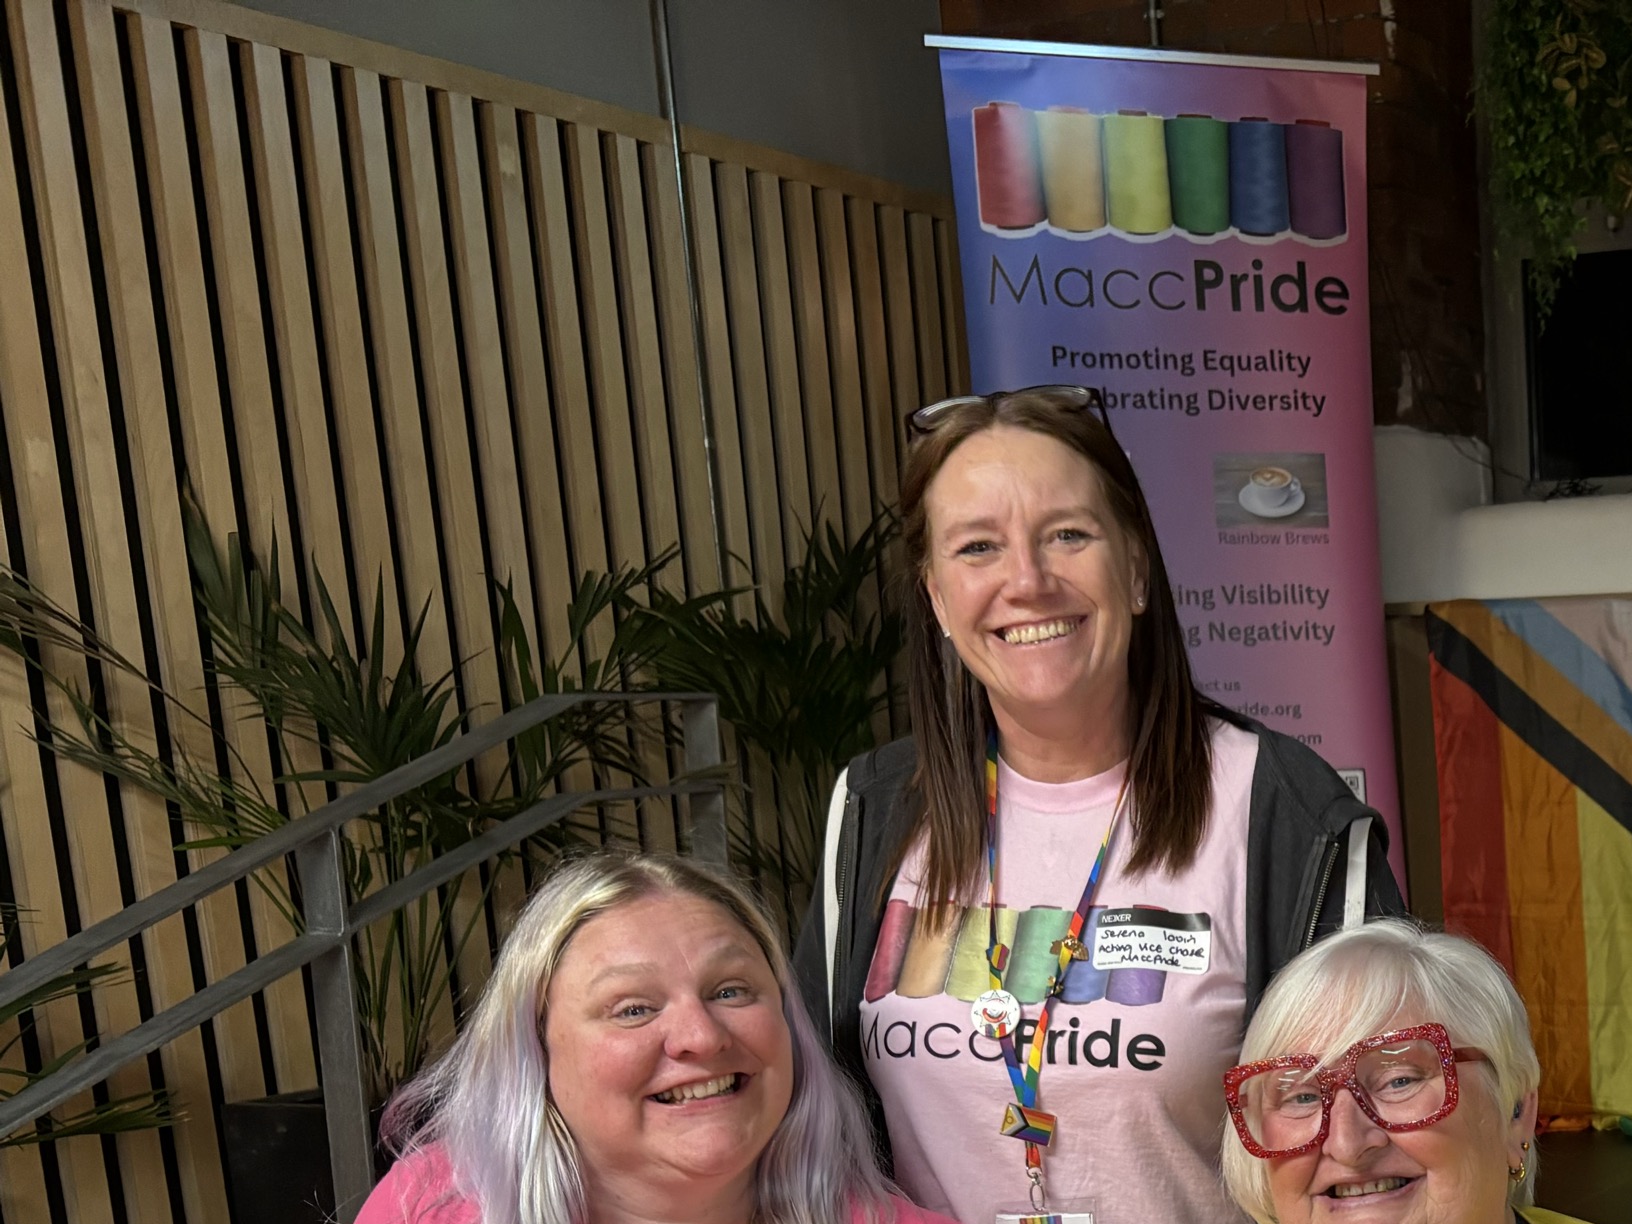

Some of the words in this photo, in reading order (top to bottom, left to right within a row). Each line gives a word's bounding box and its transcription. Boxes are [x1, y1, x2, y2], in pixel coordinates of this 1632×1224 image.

[988, 253, 1350, 316] MaccPride
[1051, 346, 1195, 377] Promoting
[1202, 349, 1312, 378] Equality
[1099, 386, 1200, 417] brating
[1207, 387, 1326, 417] Diversity
[1218, 531, 1281, 545] Rainbow
[1286, 531, 1330, 545] Brews
[1221, 583, 1330, 610] Visibility
[1208, 620, 1336, 647] Negativity
[1223, 680, 1241, 691] us
